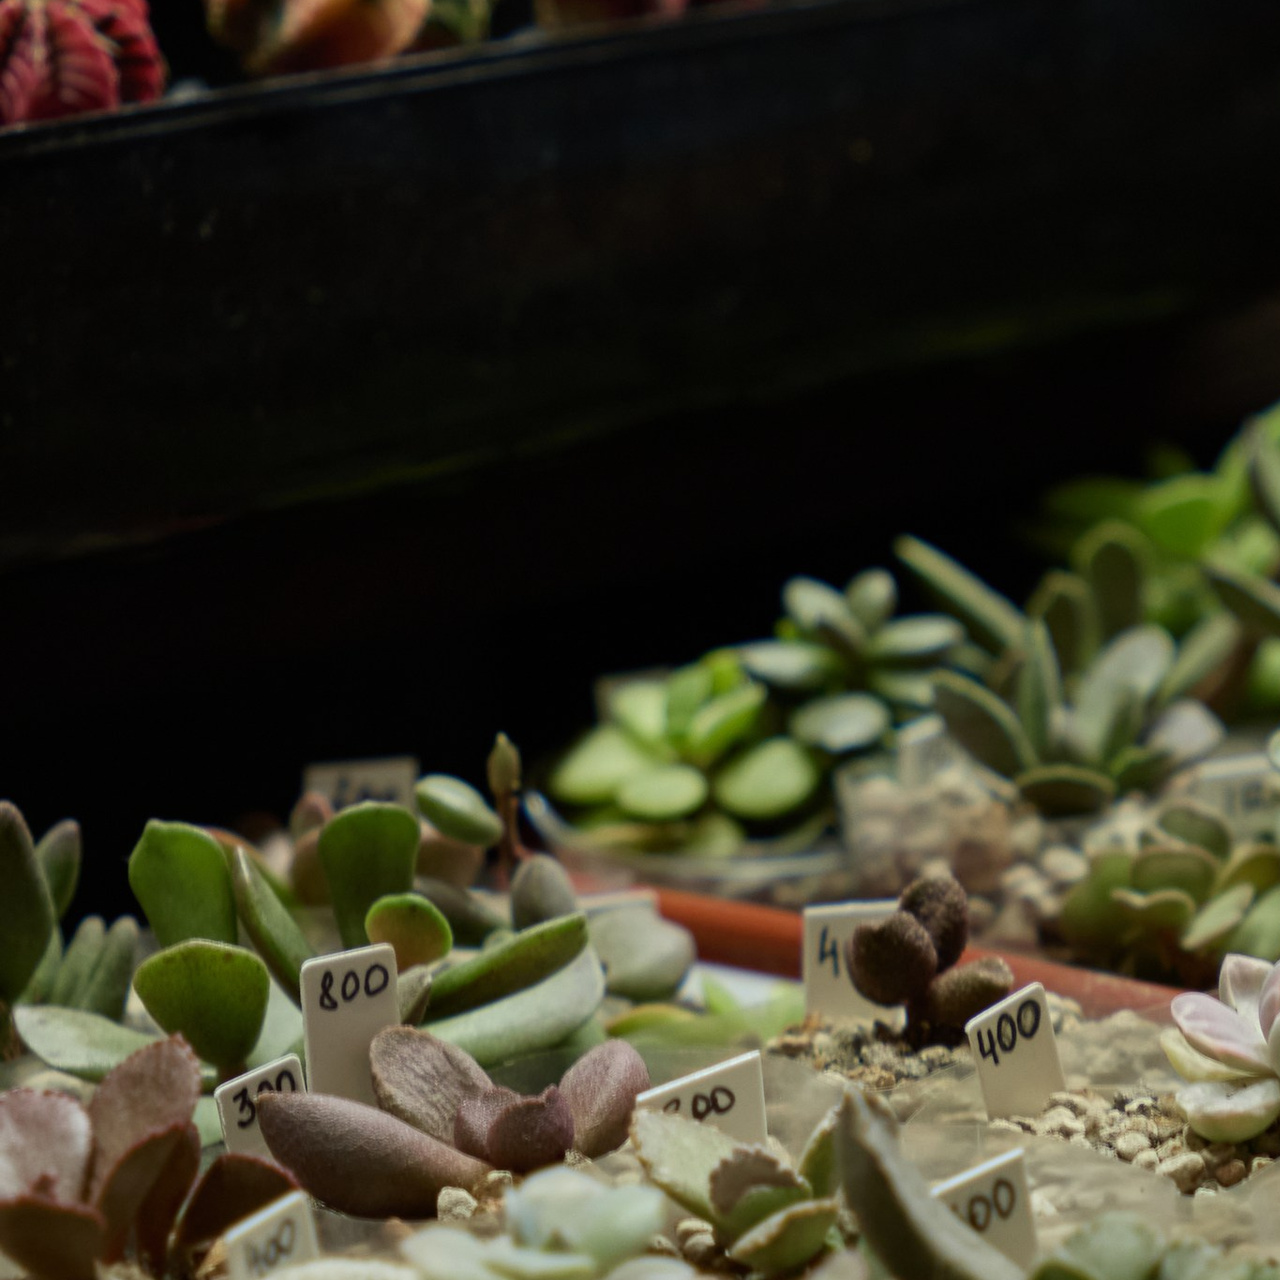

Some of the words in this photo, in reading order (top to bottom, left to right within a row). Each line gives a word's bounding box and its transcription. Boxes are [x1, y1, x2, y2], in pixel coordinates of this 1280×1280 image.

[319, 963, 389, 1011] 800
[977, 999, 1041, 1065] 400
[951, 1177, 1015, 1232] 00
